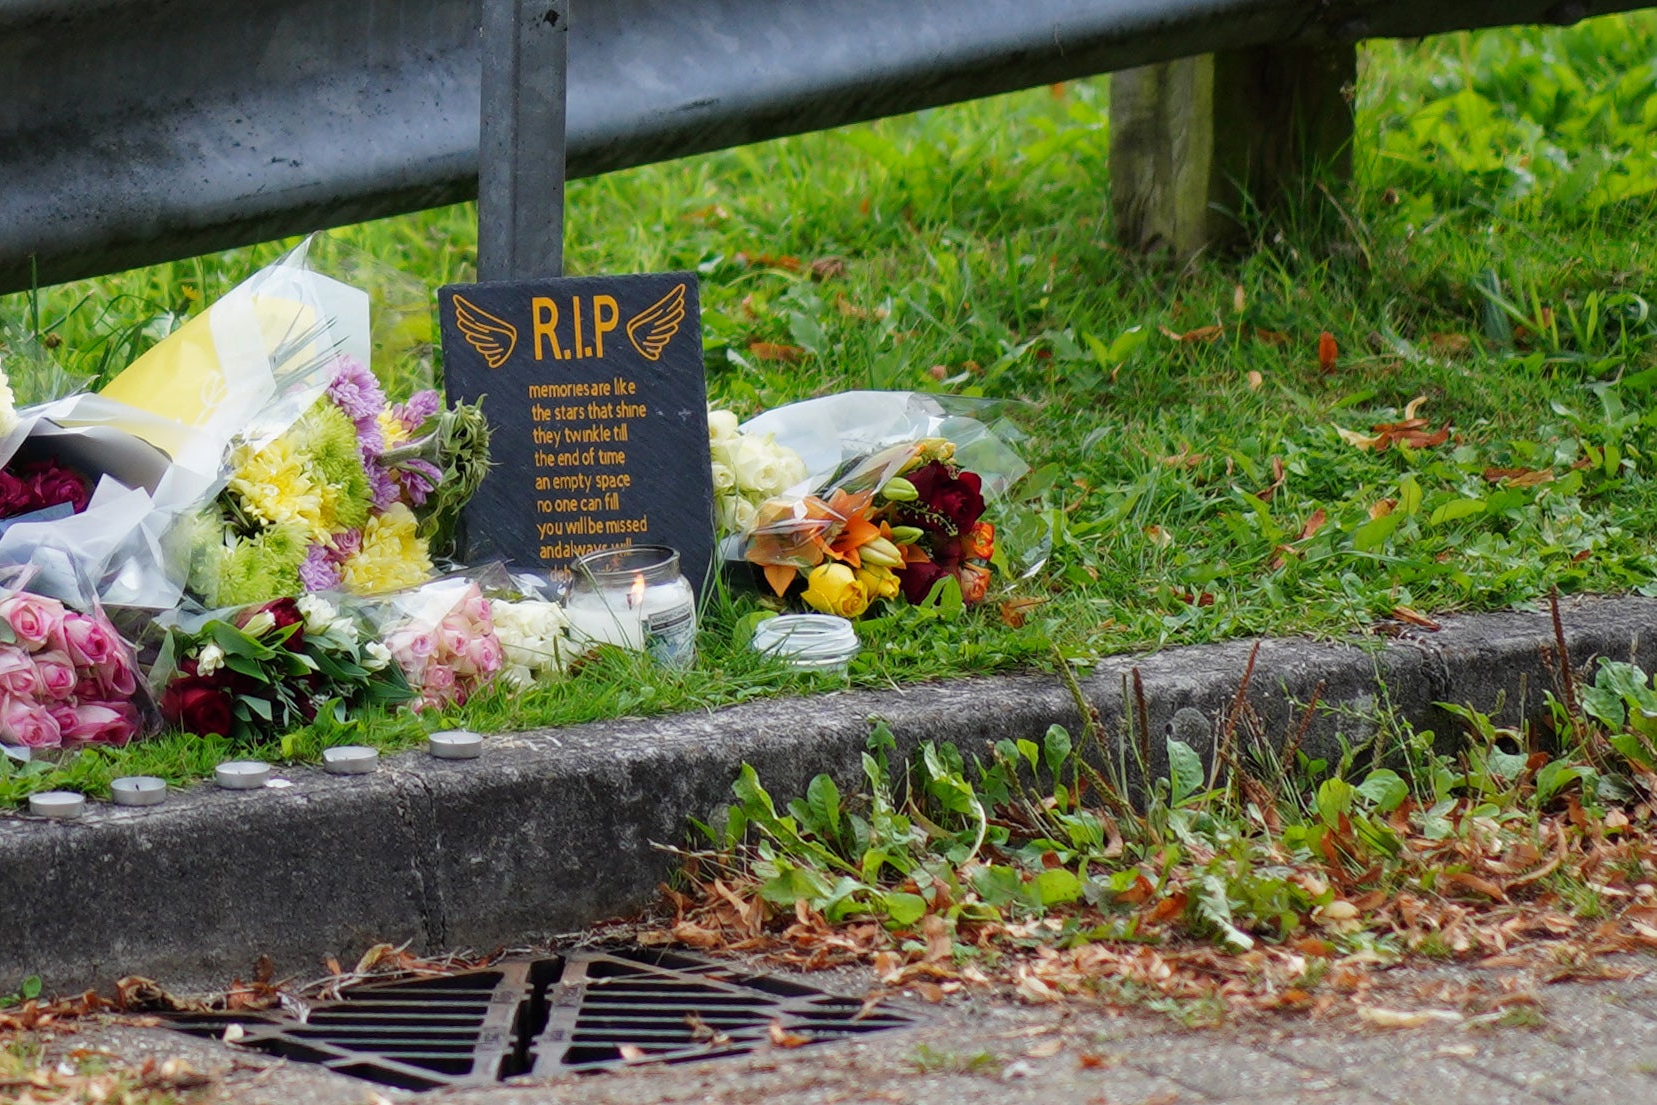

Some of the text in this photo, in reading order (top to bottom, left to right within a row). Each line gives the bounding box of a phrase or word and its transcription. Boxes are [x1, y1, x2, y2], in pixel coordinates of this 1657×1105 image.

[531, 294, 620, 361] R.I.P
[528, 377, 636, 399] memories are like
[531, 400, 647, 422] the stars that shine
[533, 423, 628, 448] they twinkle till
[534, 447, 626, 467] the end of time
[535, 473, 631, 493] an empty space
[537, 492, 620, 513] no one can fill
[536, 514, 648, 540] you will be missed
[539, 540, 563, 559] and
